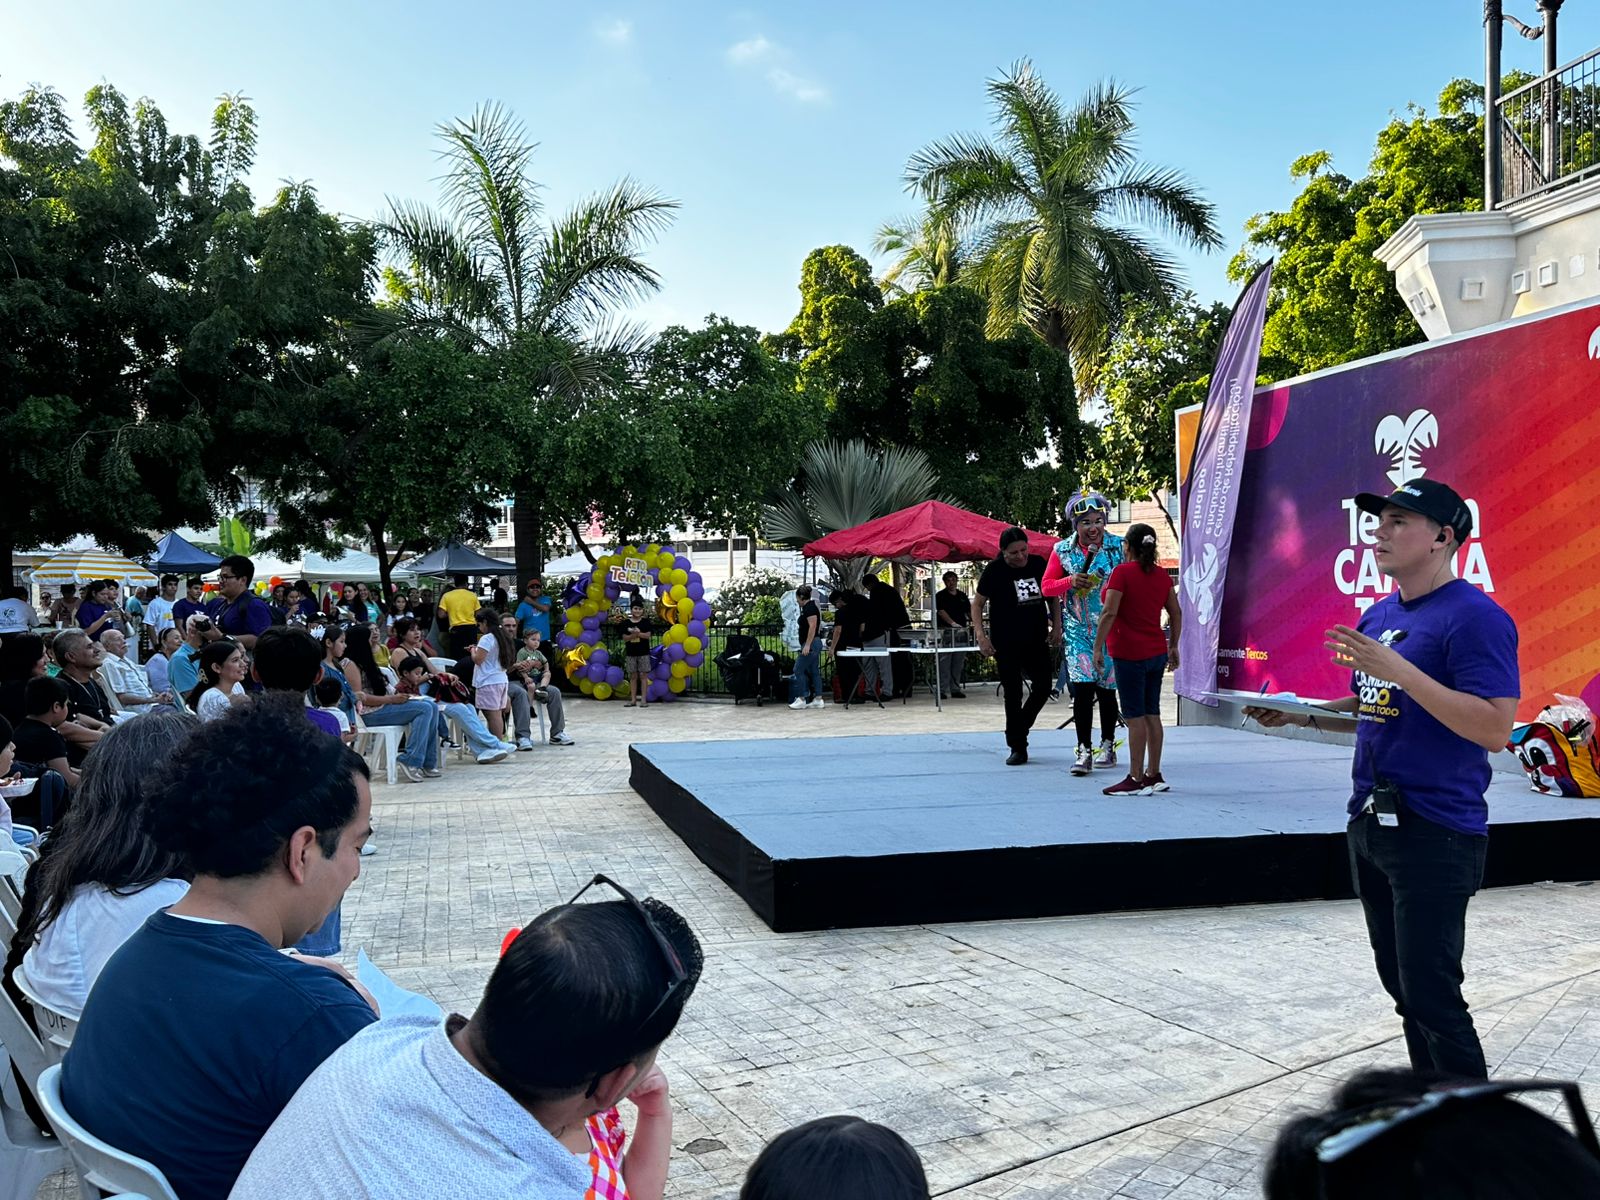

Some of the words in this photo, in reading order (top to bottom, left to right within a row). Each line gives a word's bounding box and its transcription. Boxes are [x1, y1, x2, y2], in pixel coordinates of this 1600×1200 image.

[625, 558, 647, 570] RETO
[1333, 541, 1495, 595] CAA
[611, 566, 653, 588] Teletón
[1245, 647, 1268, 660] Tercos
